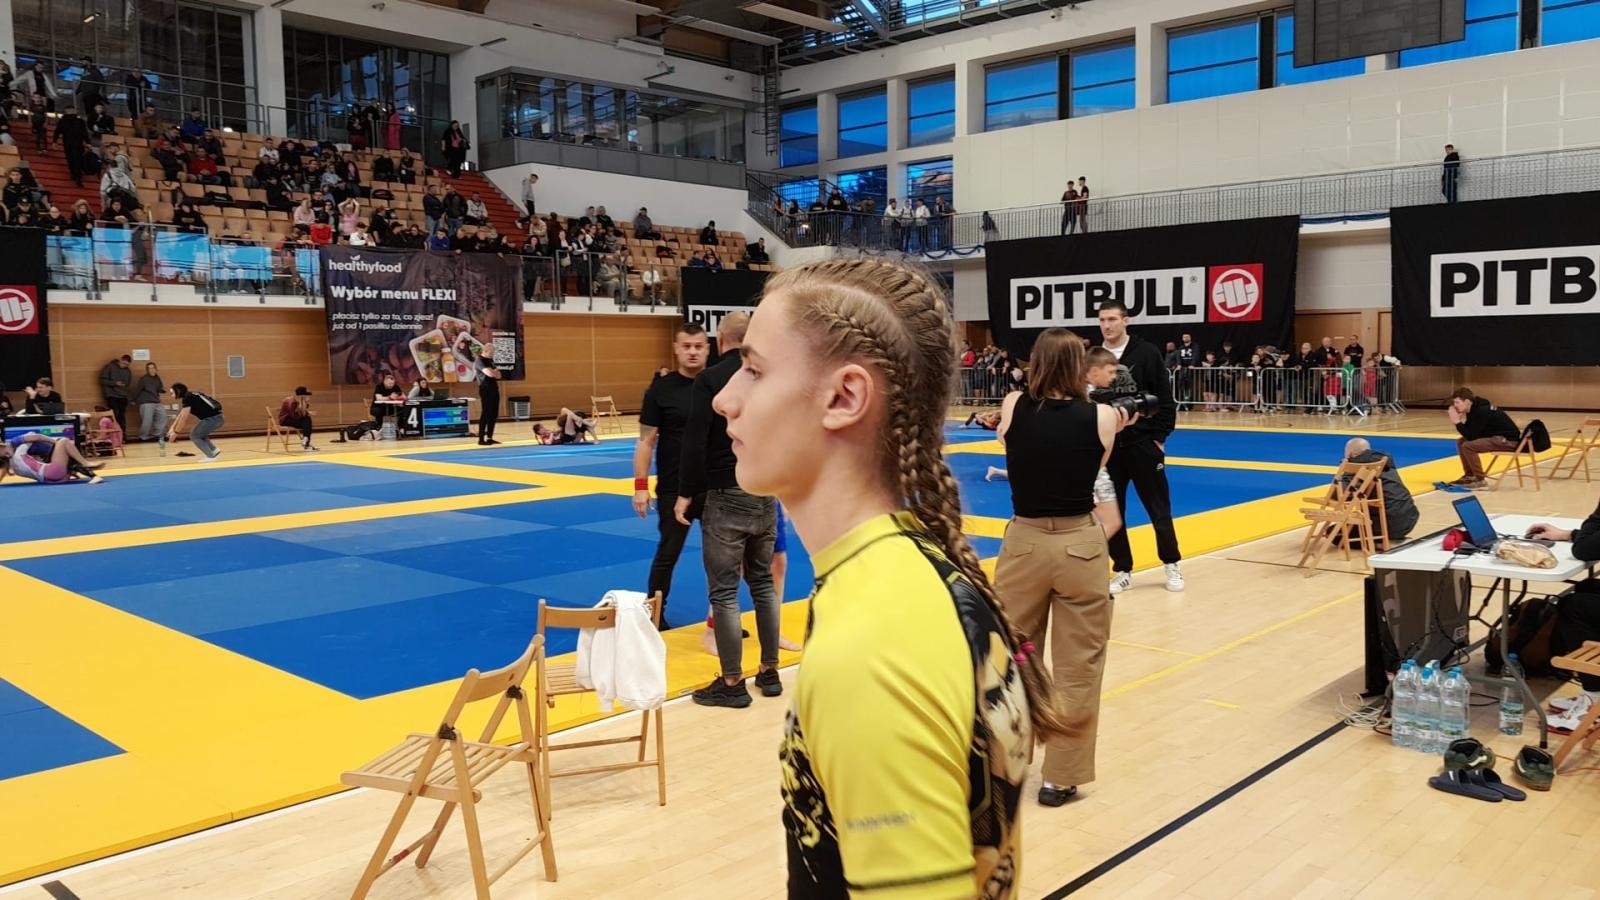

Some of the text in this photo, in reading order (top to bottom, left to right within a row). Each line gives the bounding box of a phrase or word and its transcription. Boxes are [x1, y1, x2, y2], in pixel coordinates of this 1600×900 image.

[328, 258, 402, 275] healthyfood
[330, 285, 457, 301] Wybór menu FLEXI
[1016, 276, 1197, 321] PITBULL
[361, 312, 380, 321] tylko
[345, 322, 358, 330] od
[407, 407, 419, 428] 4
